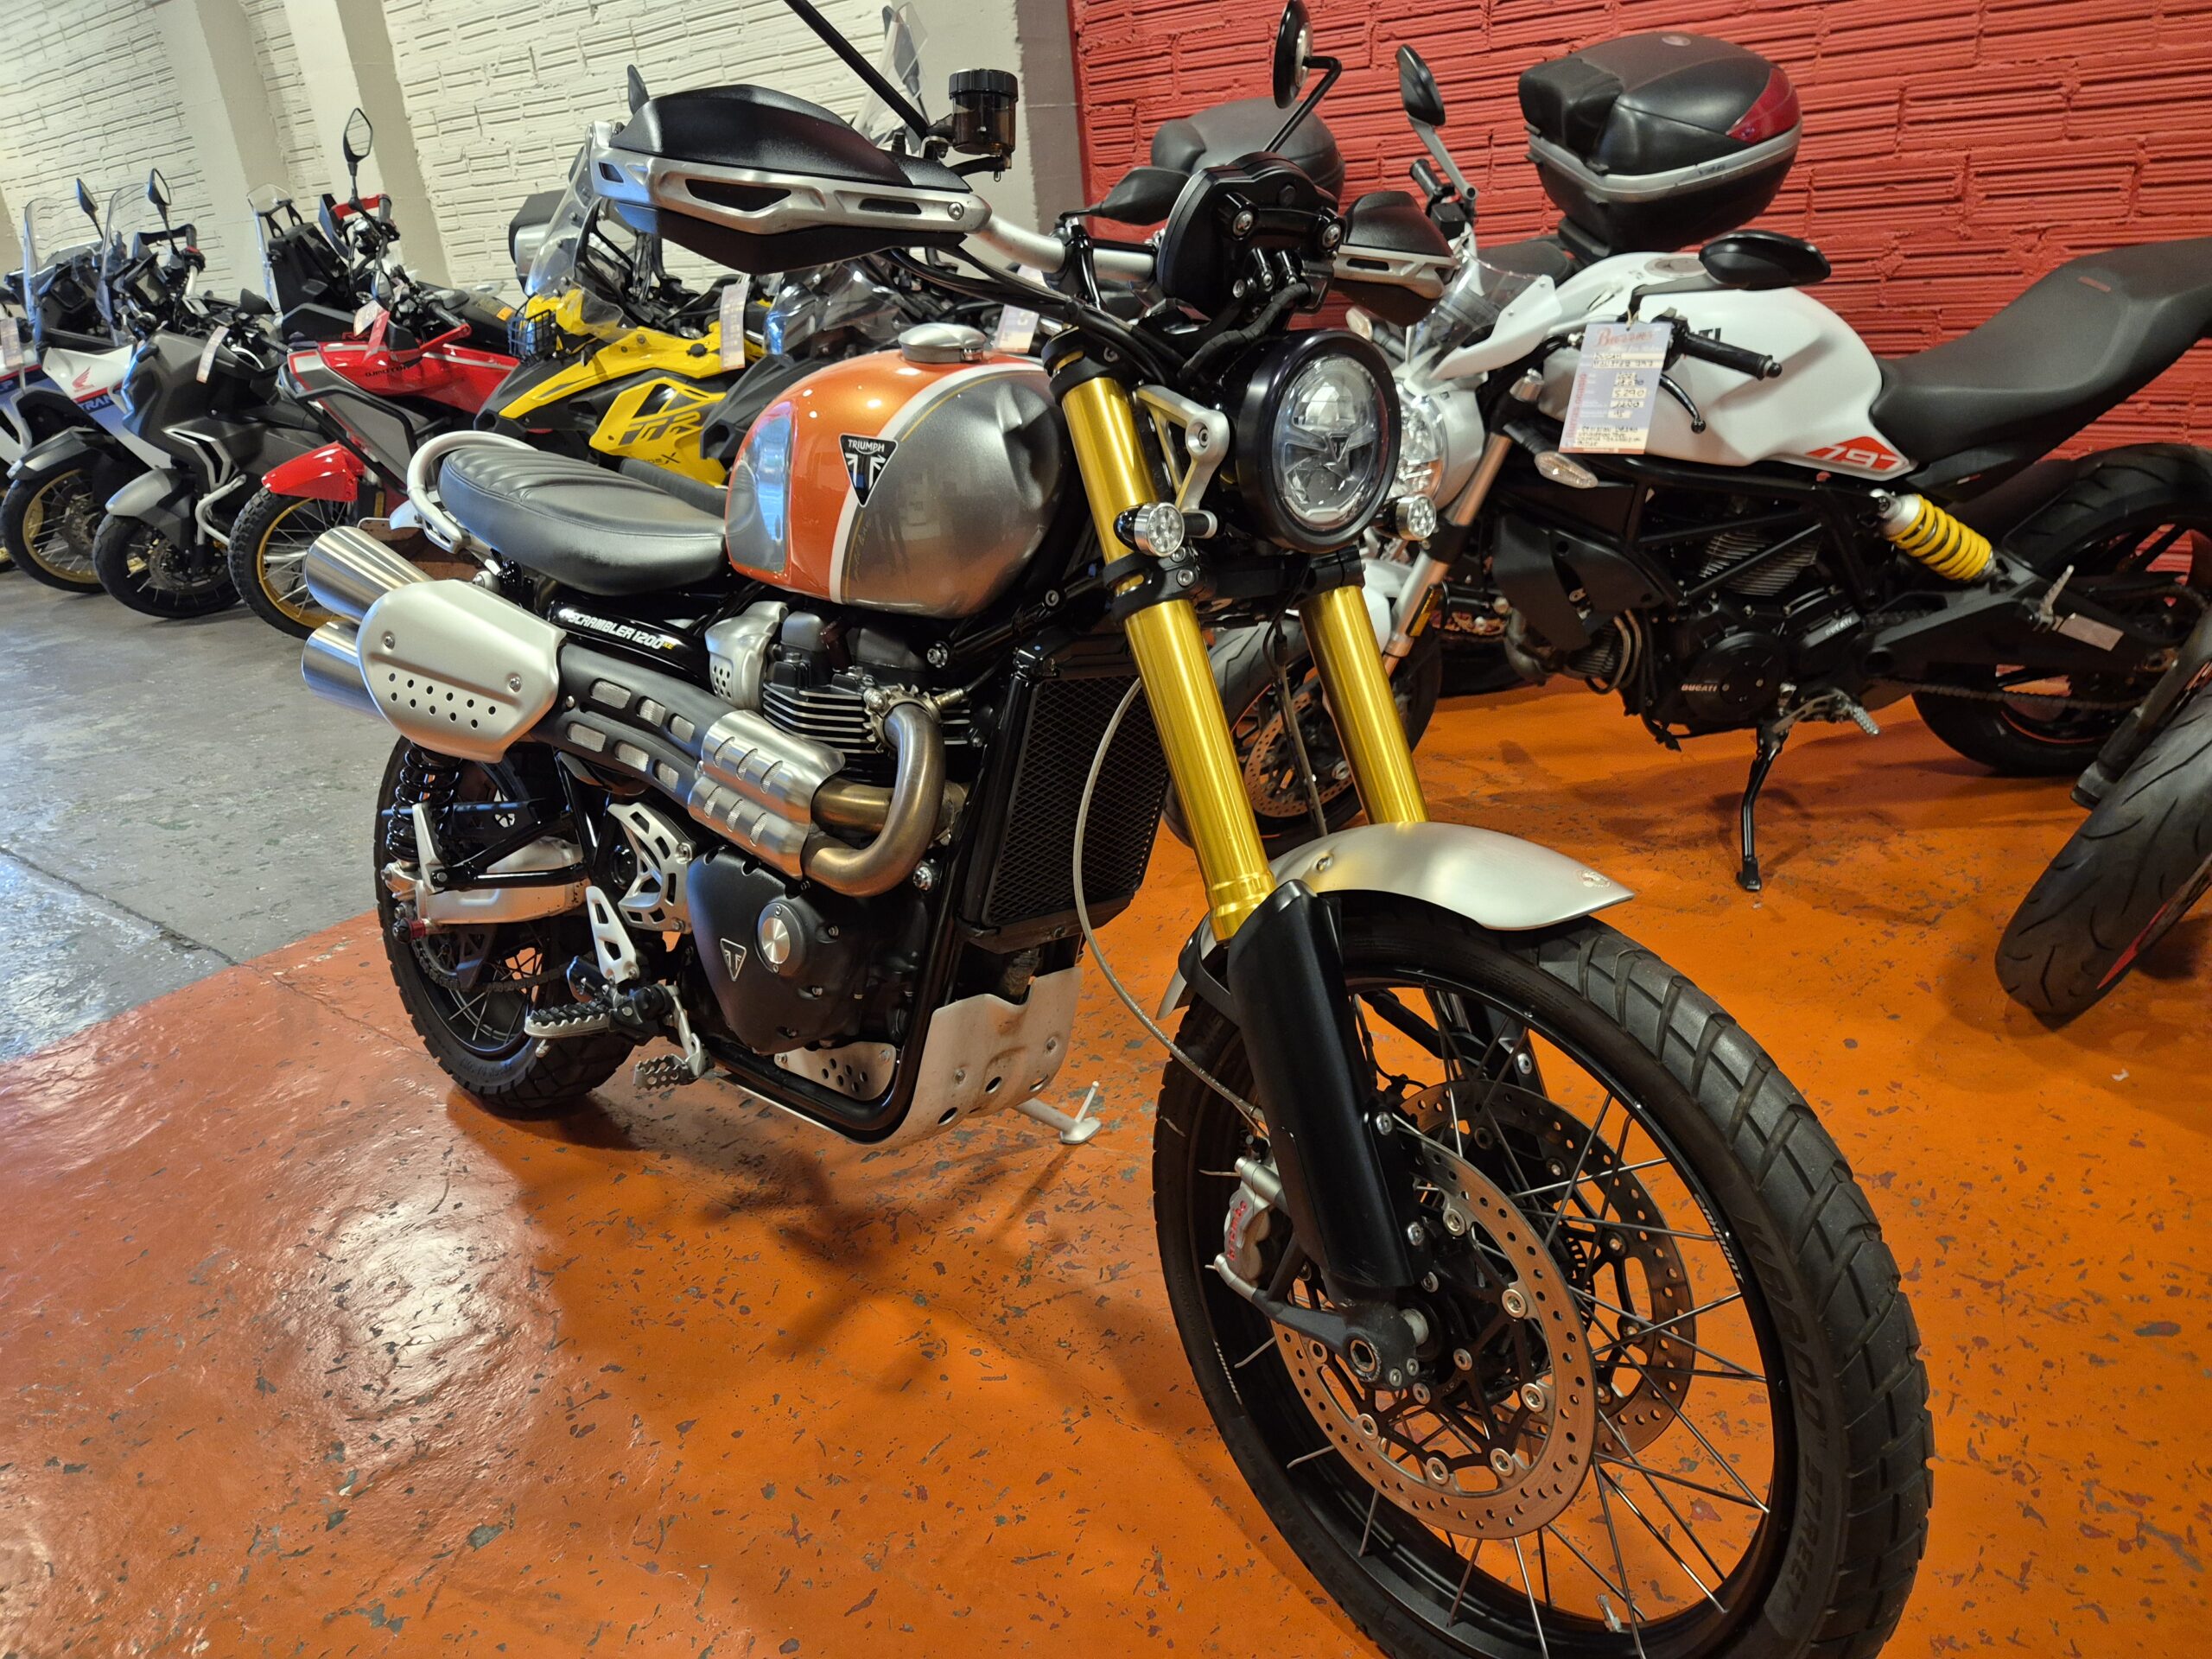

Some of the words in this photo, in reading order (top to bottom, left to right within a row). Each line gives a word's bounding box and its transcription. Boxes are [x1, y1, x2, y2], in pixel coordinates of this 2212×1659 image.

[848, 439, 885, 454] TRIUMPH
[1813, 445, 1903, 472] 797
[568, 612, 636, 640] SCRAMBLER
[632, 631, 664, 650] 1200
